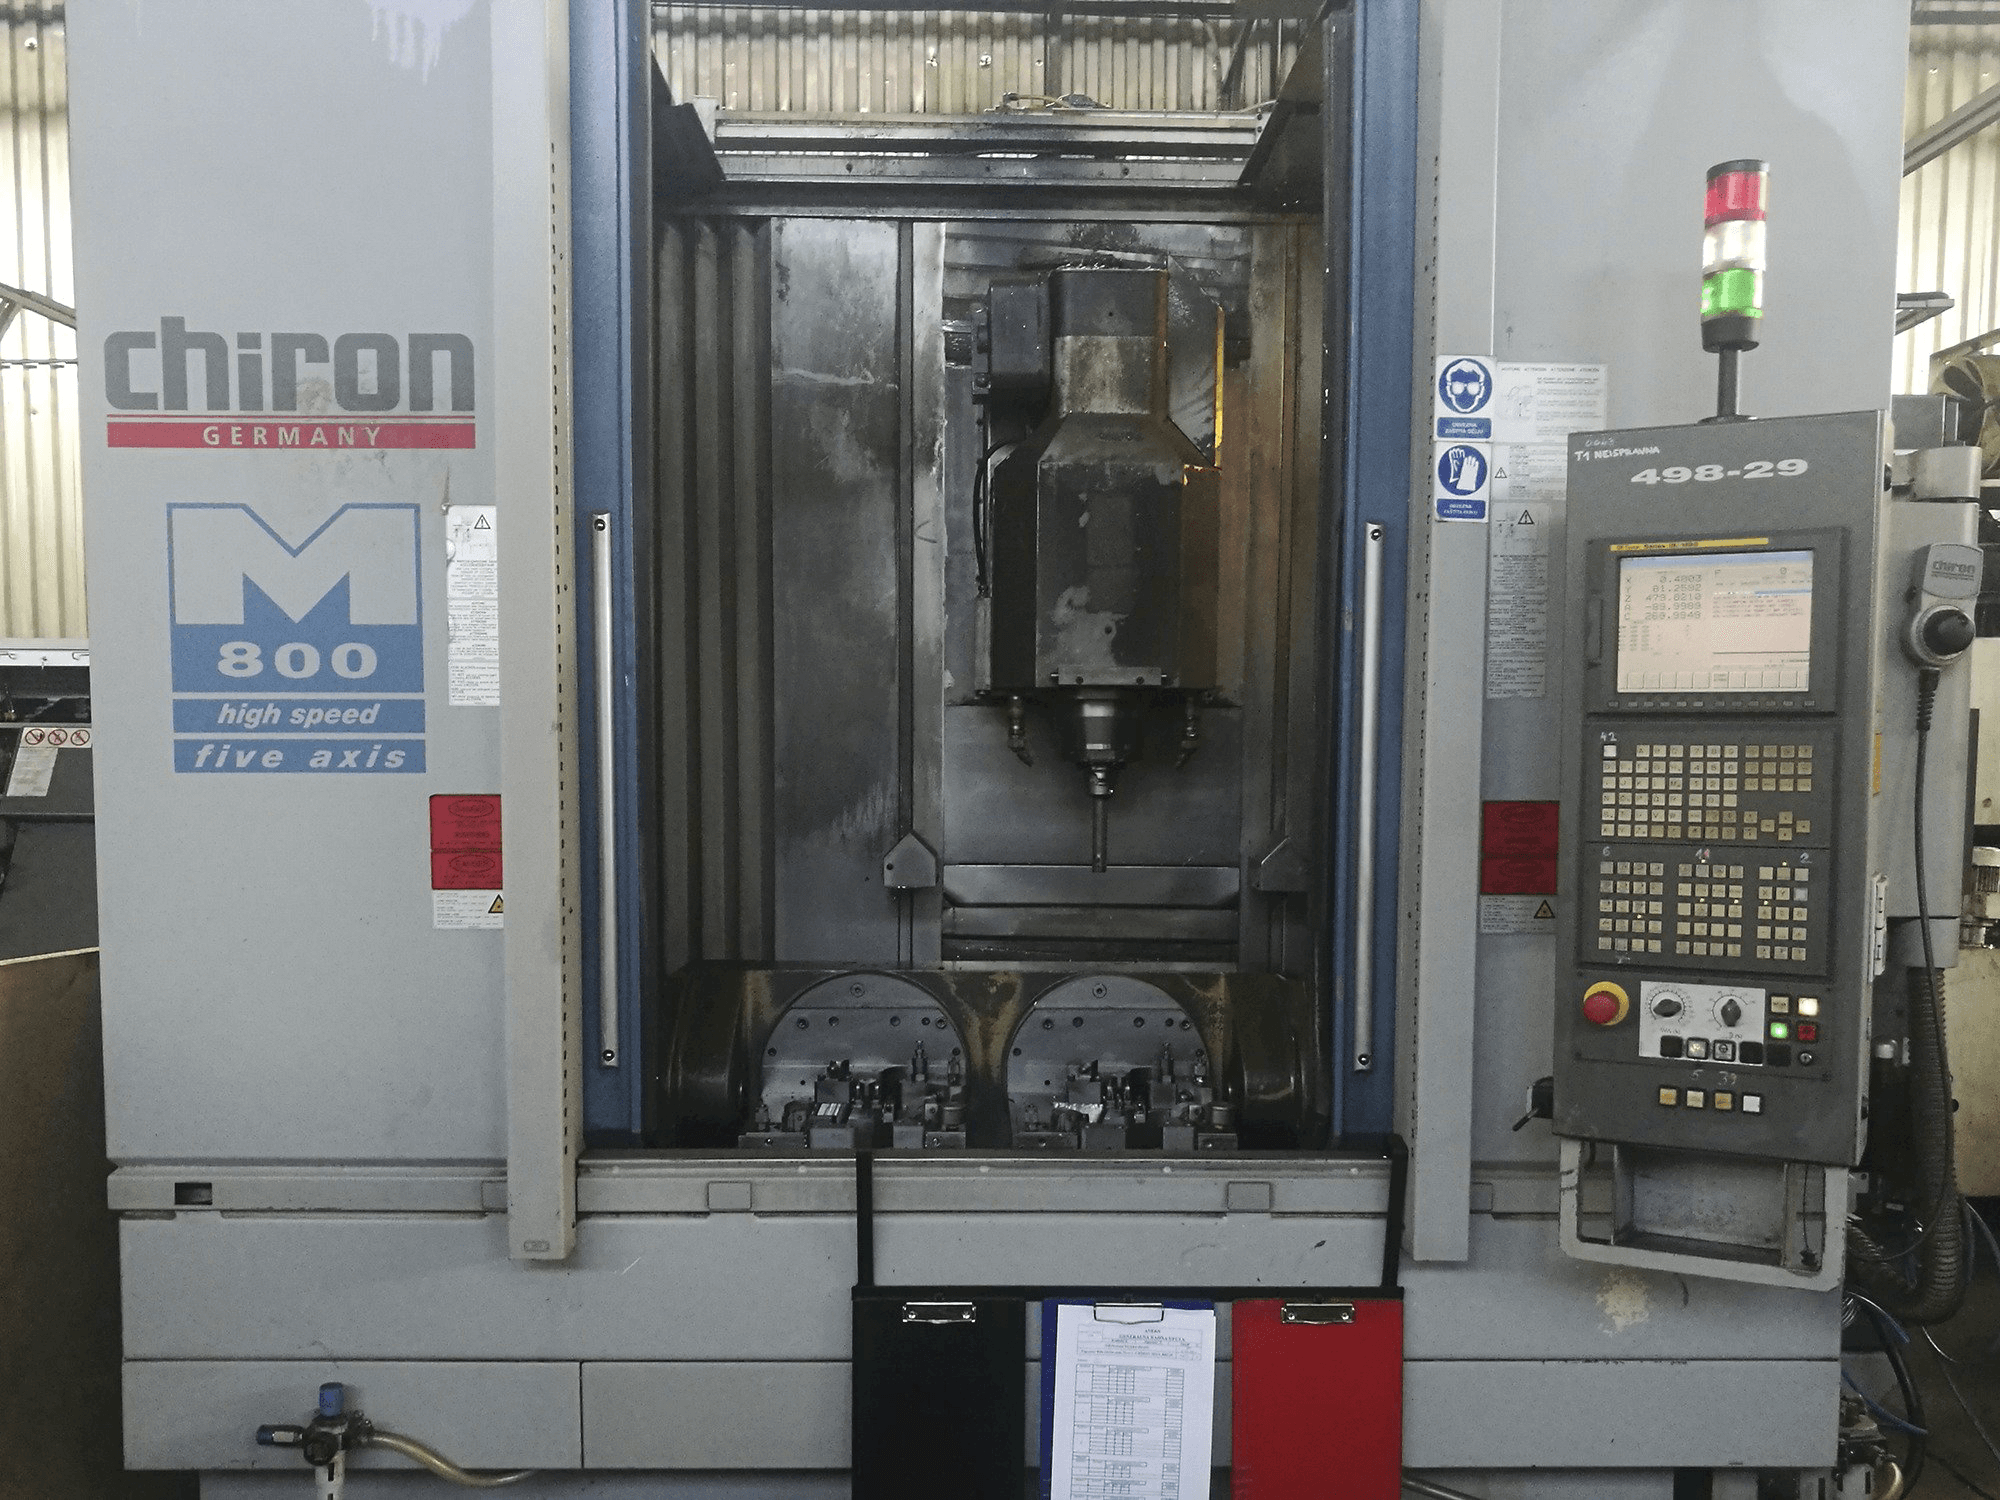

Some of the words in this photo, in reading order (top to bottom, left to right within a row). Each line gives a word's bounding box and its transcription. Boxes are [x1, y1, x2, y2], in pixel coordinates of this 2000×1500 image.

[104, 316, 475, 411] chiron
[203, 426, 381, 446] GERMANY
[1631, 459, 1808, 484] 498-29
[217, 641, 378, 679] 800
[216, 703, 282, 729] high
[289, 703, 381, 729] speed
[194, 744, 284, 768] five
[309, 744, 406, 768] axis
